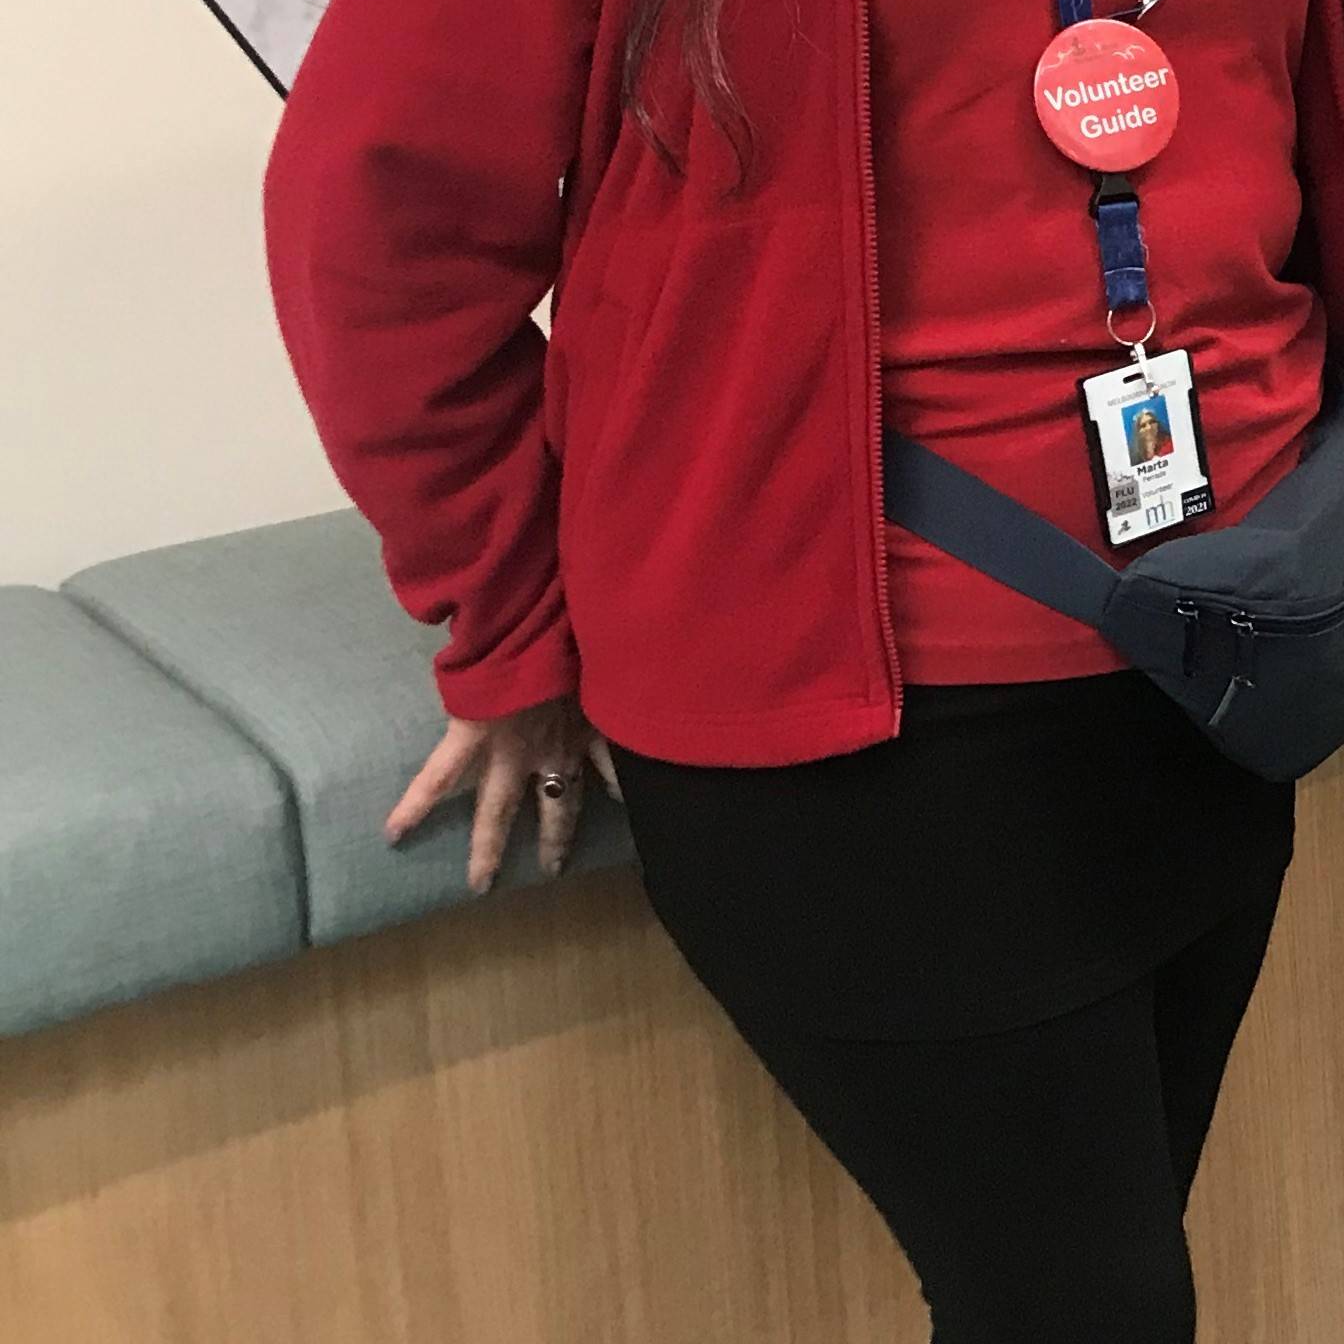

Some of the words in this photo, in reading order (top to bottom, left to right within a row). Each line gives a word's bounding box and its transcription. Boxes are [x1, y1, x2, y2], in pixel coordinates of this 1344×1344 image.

[1043, 67, 1169, 111] Volunteer
[1080, 104, 1158, 138] Guide
[1136, 459, 1169, 476] Marta
[1115, 486, 1135, 498] FLU
